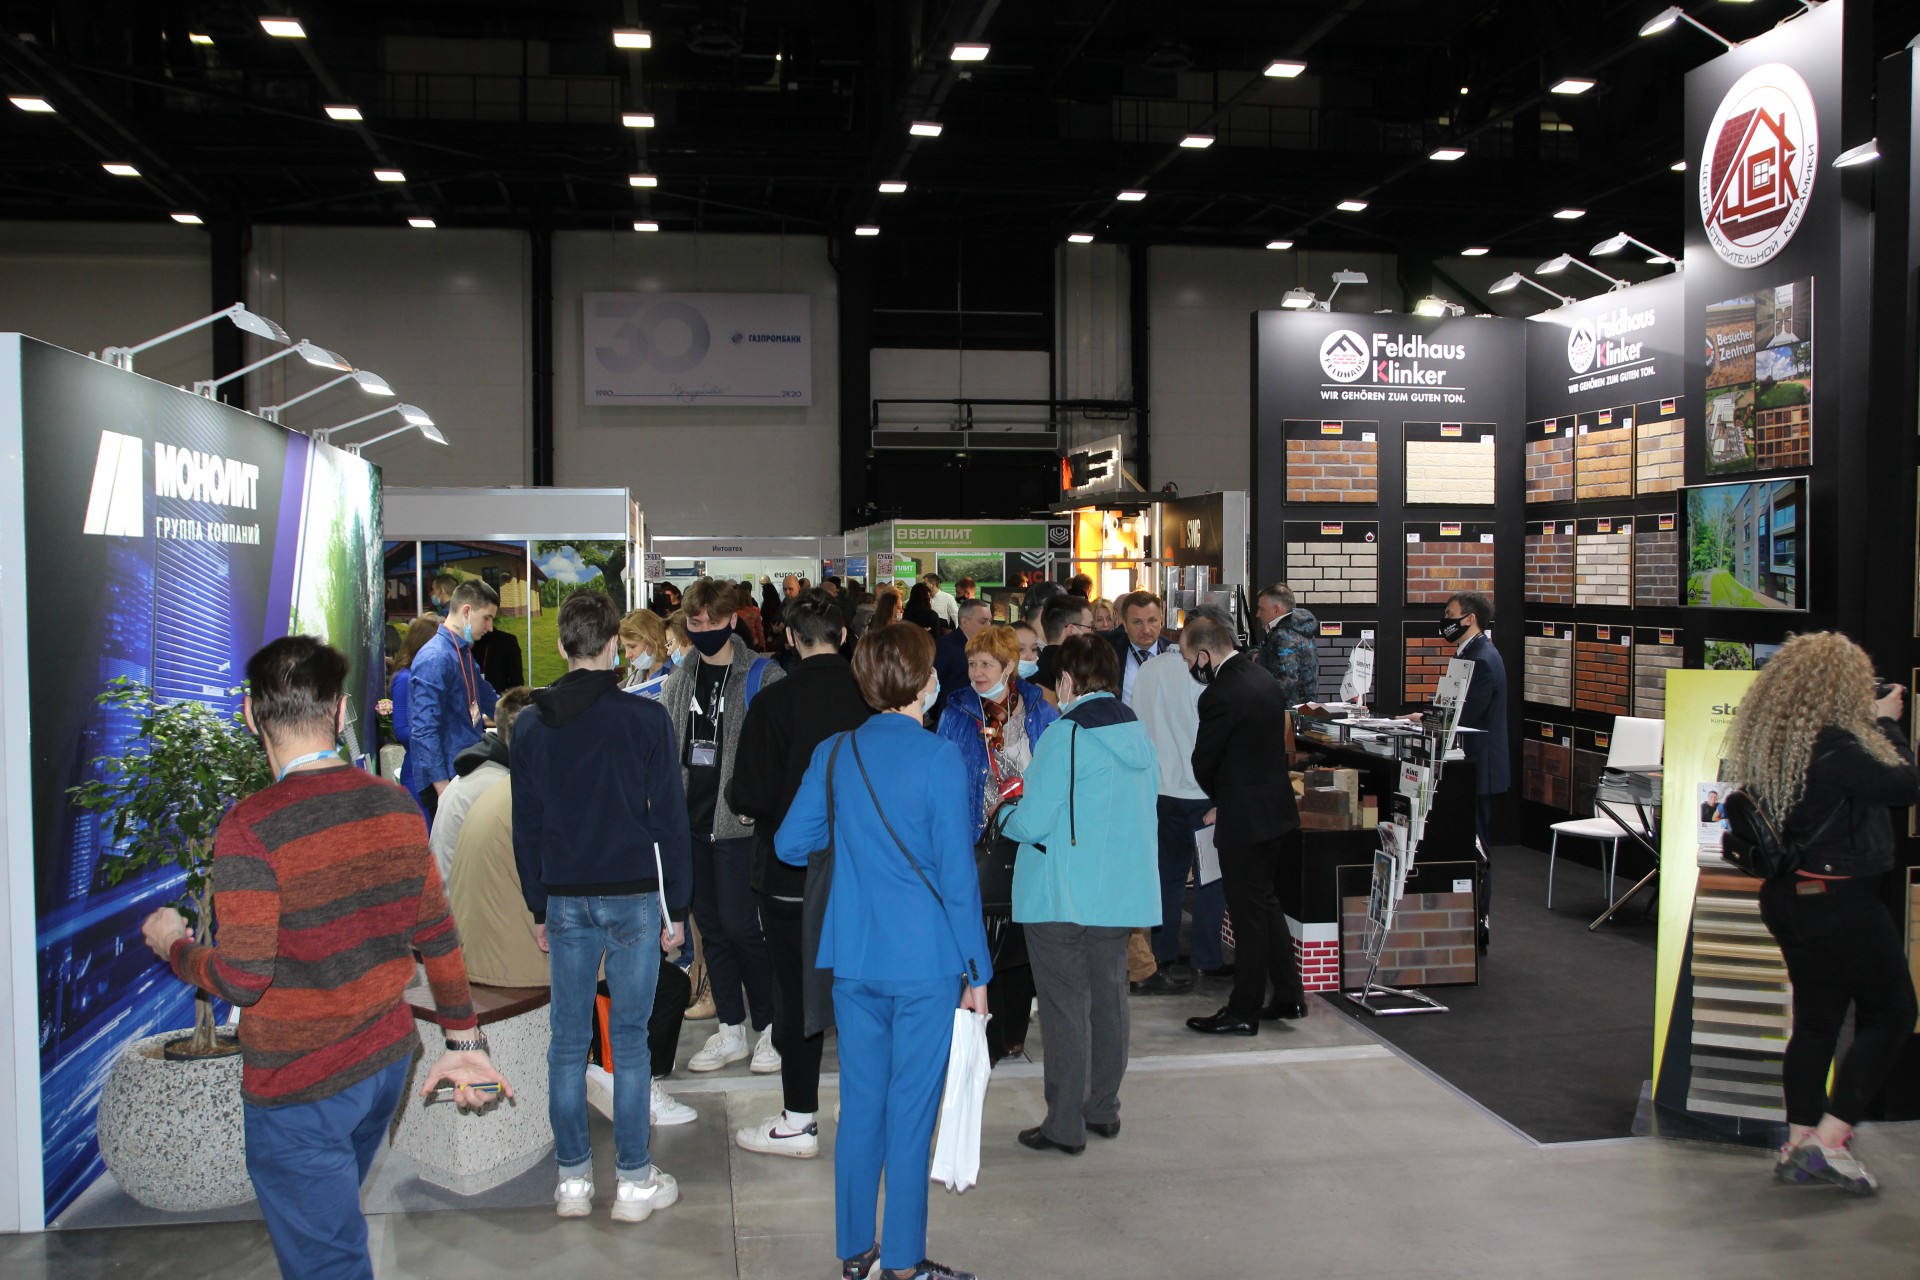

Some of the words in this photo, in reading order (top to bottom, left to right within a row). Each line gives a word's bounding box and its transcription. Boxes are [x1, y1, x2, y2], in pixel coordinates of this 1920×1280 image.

[1707, 224, 1779, 264] СТРОИТЕЛЬНОЙ
[1783, 143, 1815, 237] КЕРАМИКИ
[595, 300, 710, 374] 30
[1596, 306, 1655, 341] Feldhaus
[748, 334, 801, 344] ГАЗПРОМБАНК
[1372, 333, 1465, 360] Feldhaus
[1716, 329, 1753, 346] Besucher
[1596, 337, 1643, 368] Klinker
[1719, 343, 1755, 362] Zentrum
[1324, 357, 1366, 379] FELDHAUS
[1372, 359, 1447, 385] Klinker
[1568, 383, 1579, 394] WIR
[1579, 377, 1605, 392] GEHÖREN
[1606, 374, 1619, 386] ZUM
[1619, 369, 1640, 382] GUTEN
[1640, 365, 1656, 377] TON.
[1320, 391, 1339, 400] WIR
[1341, 389, 1386, 401] GEHÖREN
[1388, 392, 1408, 402] ZUM
[1411, 393, 1441, 403] GUTEN
[1443, 394, 1466, 404] TON.
[155, 441, 259, 510] МОНОЛИТ
[155, 516, 203, 541] ГРУППА
[207, 521, 261, 546] КОМПАНИЙ
[909, 528, 972, 540] БЕЛПЛИТ
